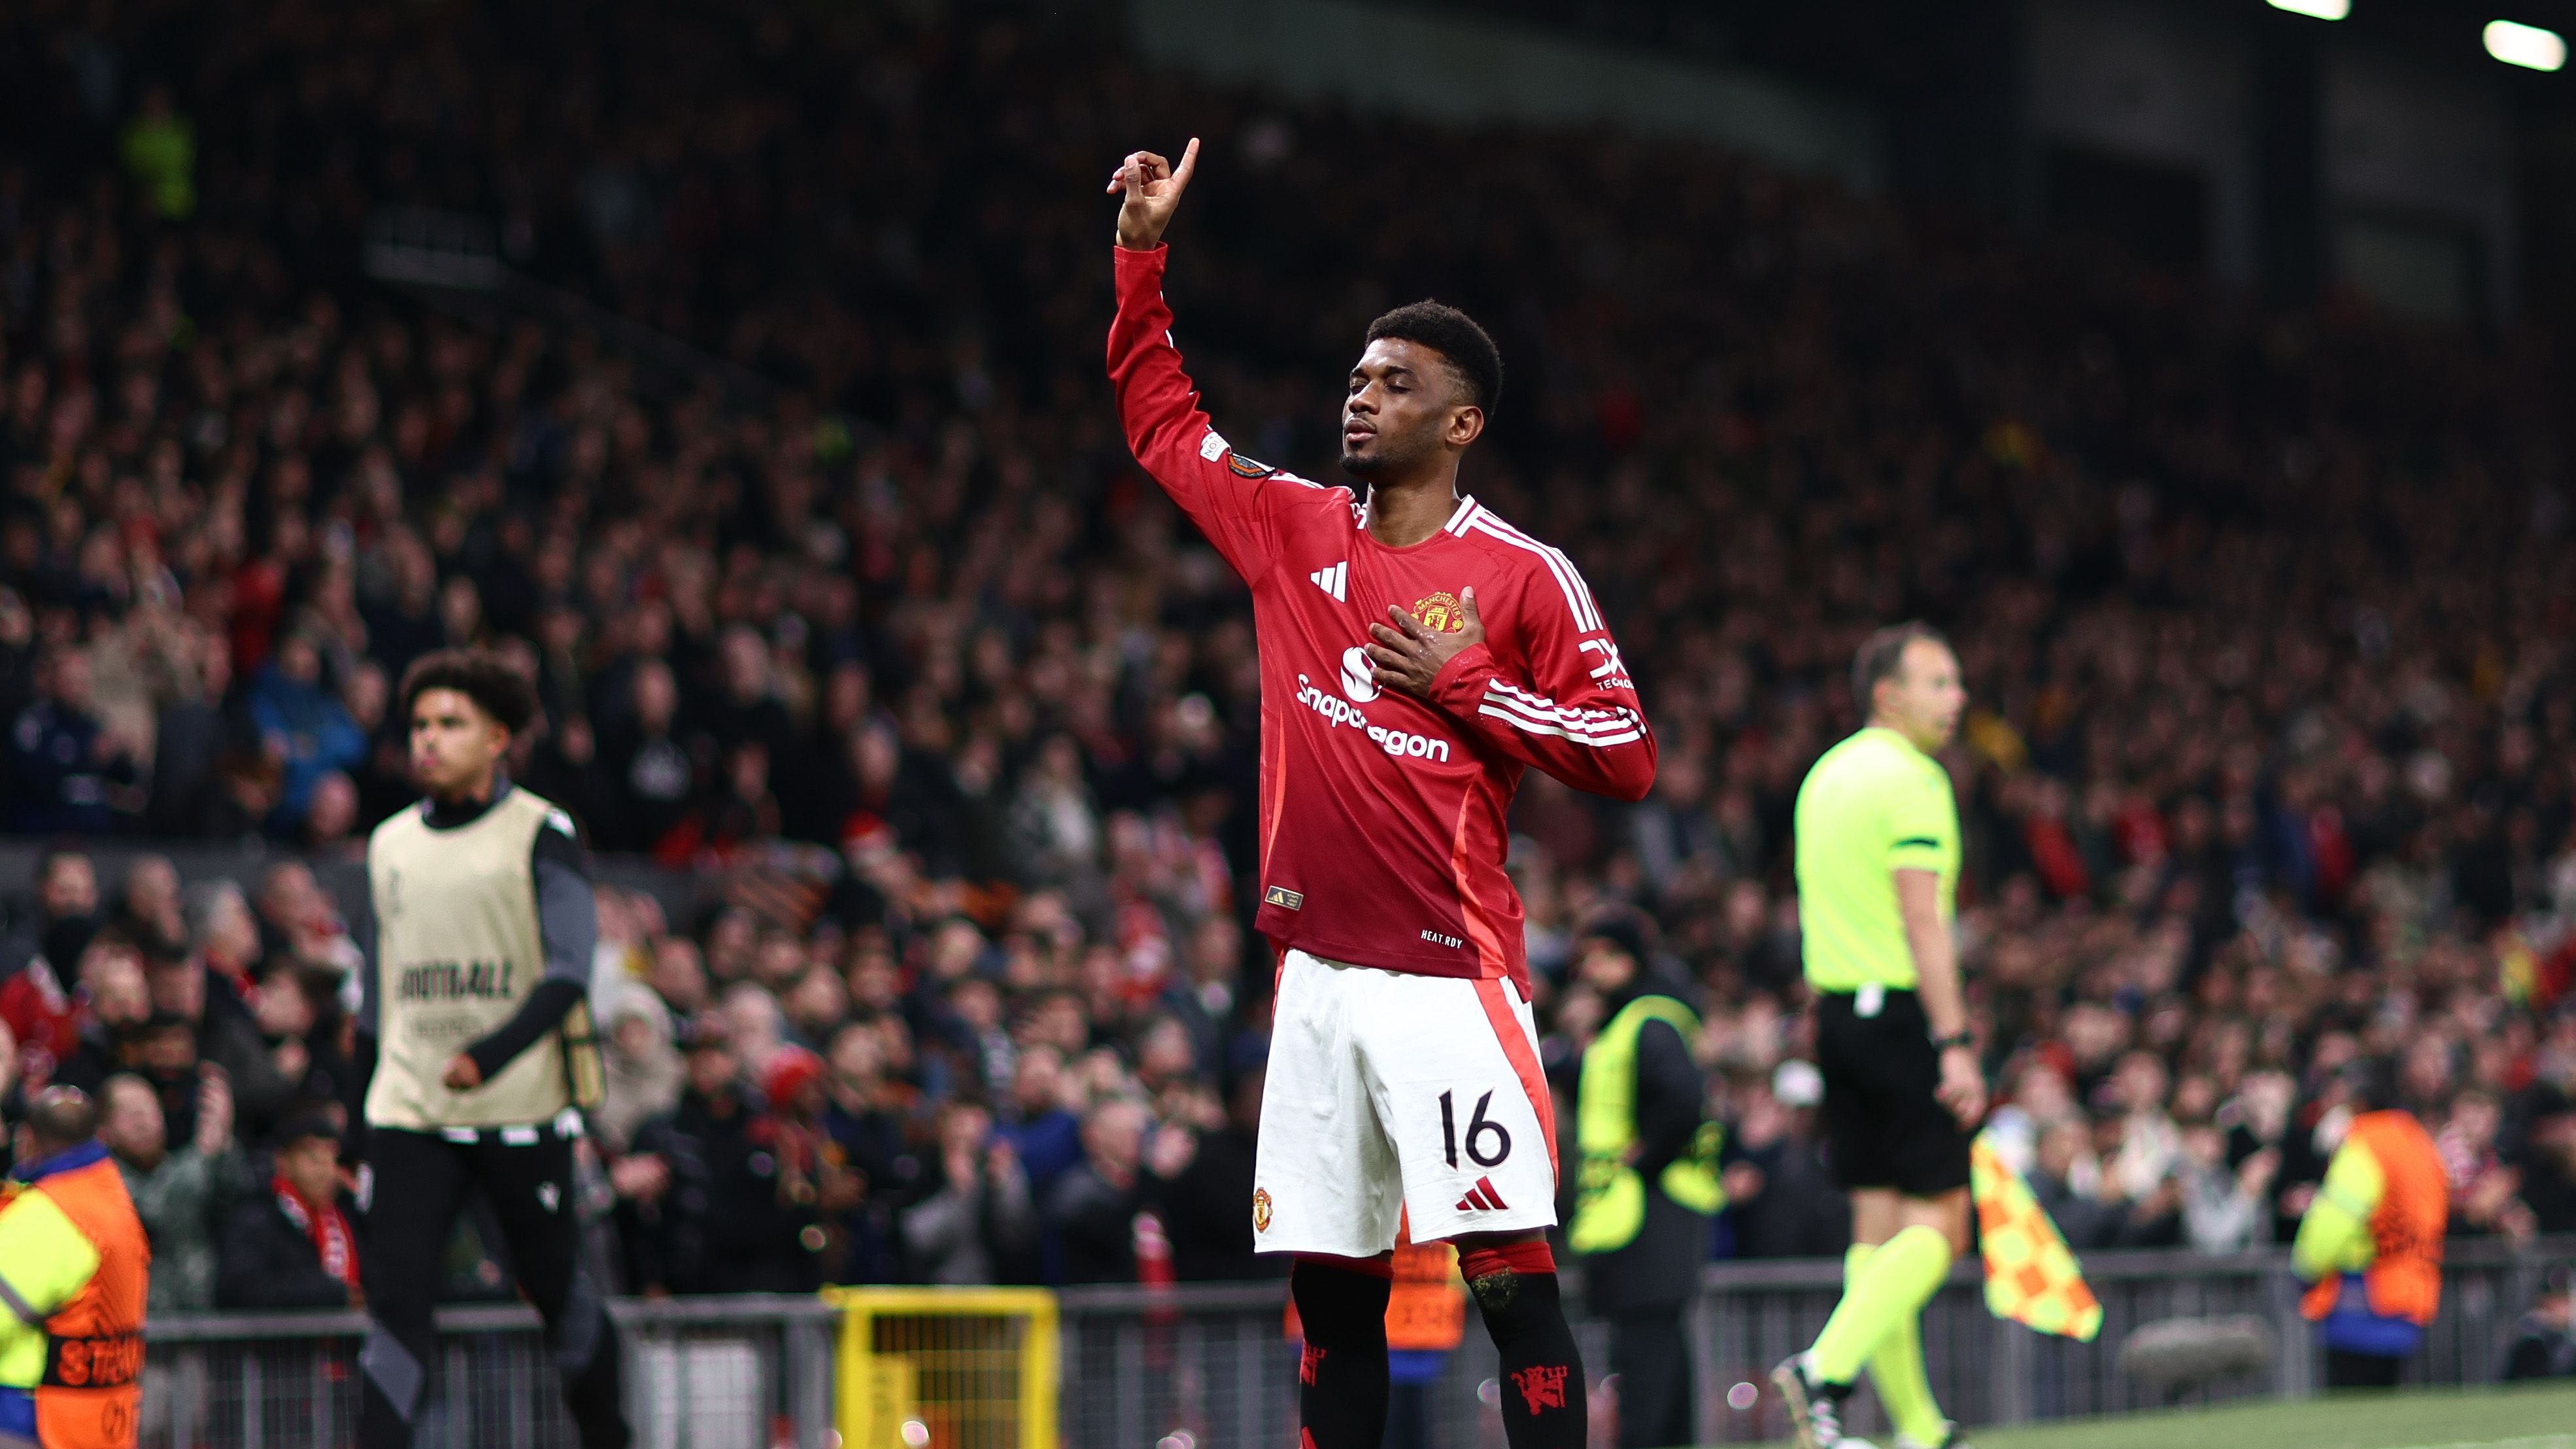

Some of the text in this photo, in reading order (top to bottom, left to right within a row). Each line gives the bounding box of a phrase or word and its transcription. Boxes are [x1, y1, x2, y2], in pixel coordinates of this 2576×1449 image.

[1418, 596, 1461, 616] MANCHESTER
[1421, 929, 1463, 949] HEAT.RDY
[1438, 1087, 1511, 1171] 16
